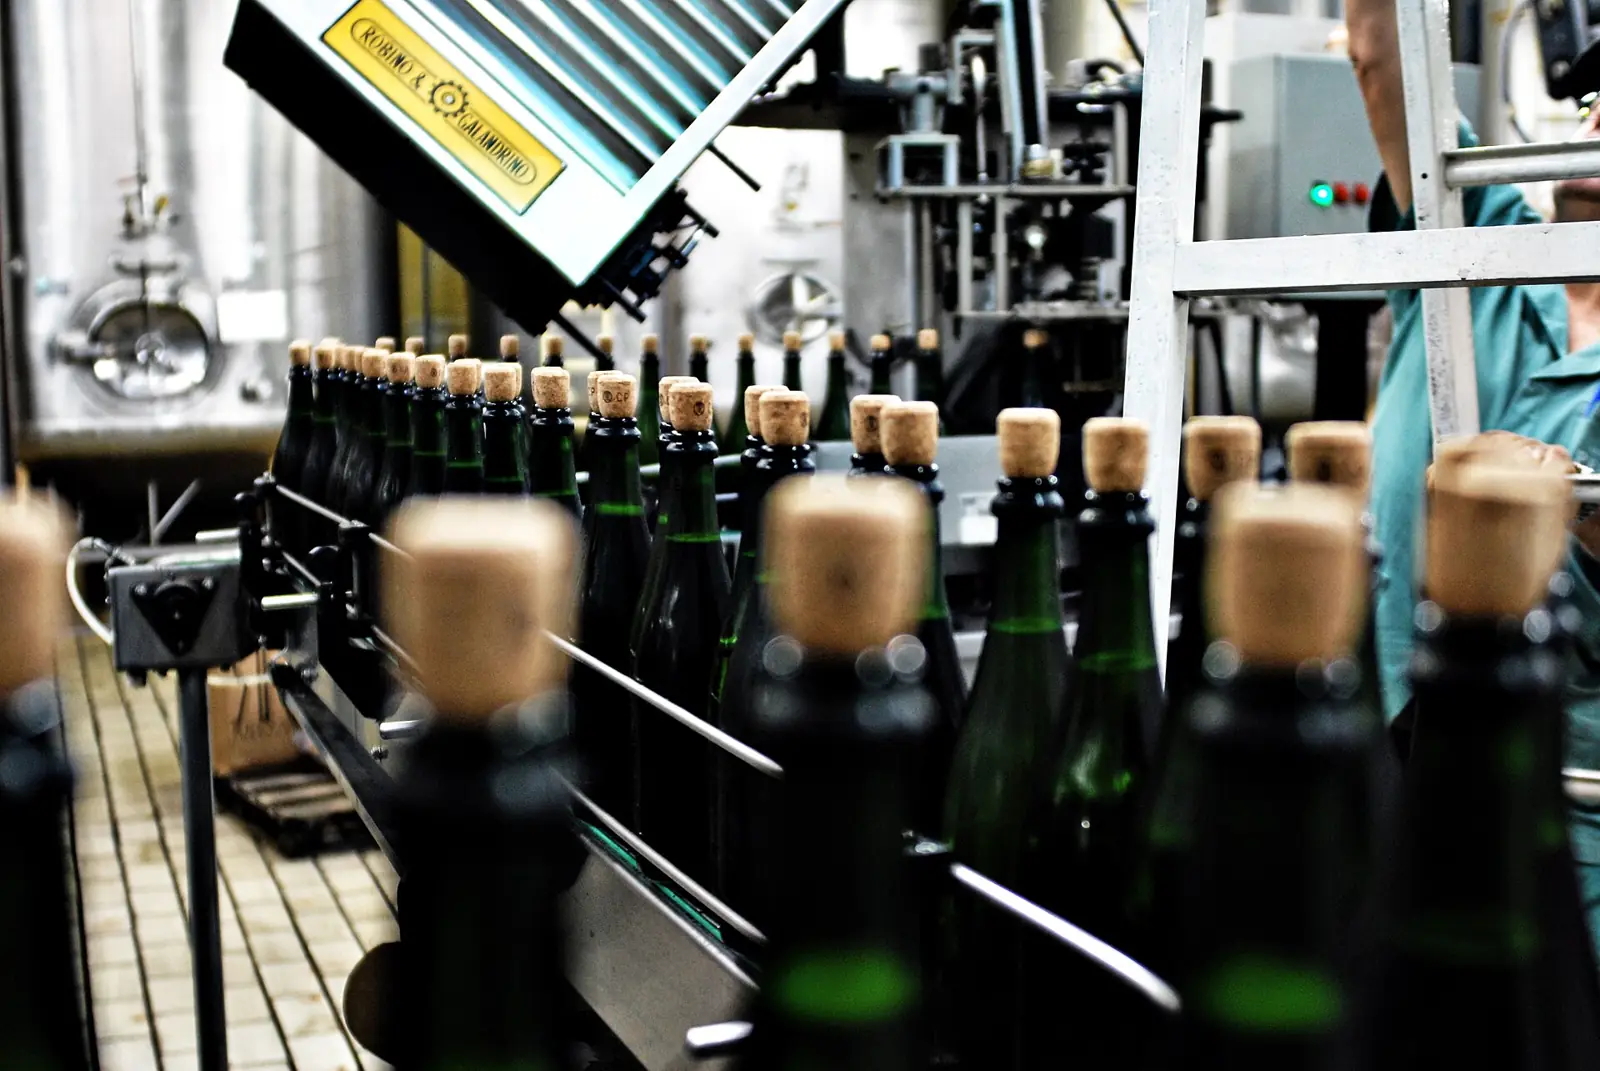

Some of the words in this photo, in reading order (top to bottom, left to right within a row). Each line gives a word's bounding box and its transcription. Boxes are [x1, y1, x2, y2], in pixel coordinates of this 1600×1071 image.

[359, 26, 414, 75] ROBINO
[409, 72, 426, 90] &
[457, 112, 529, 178] GALANDRINO
